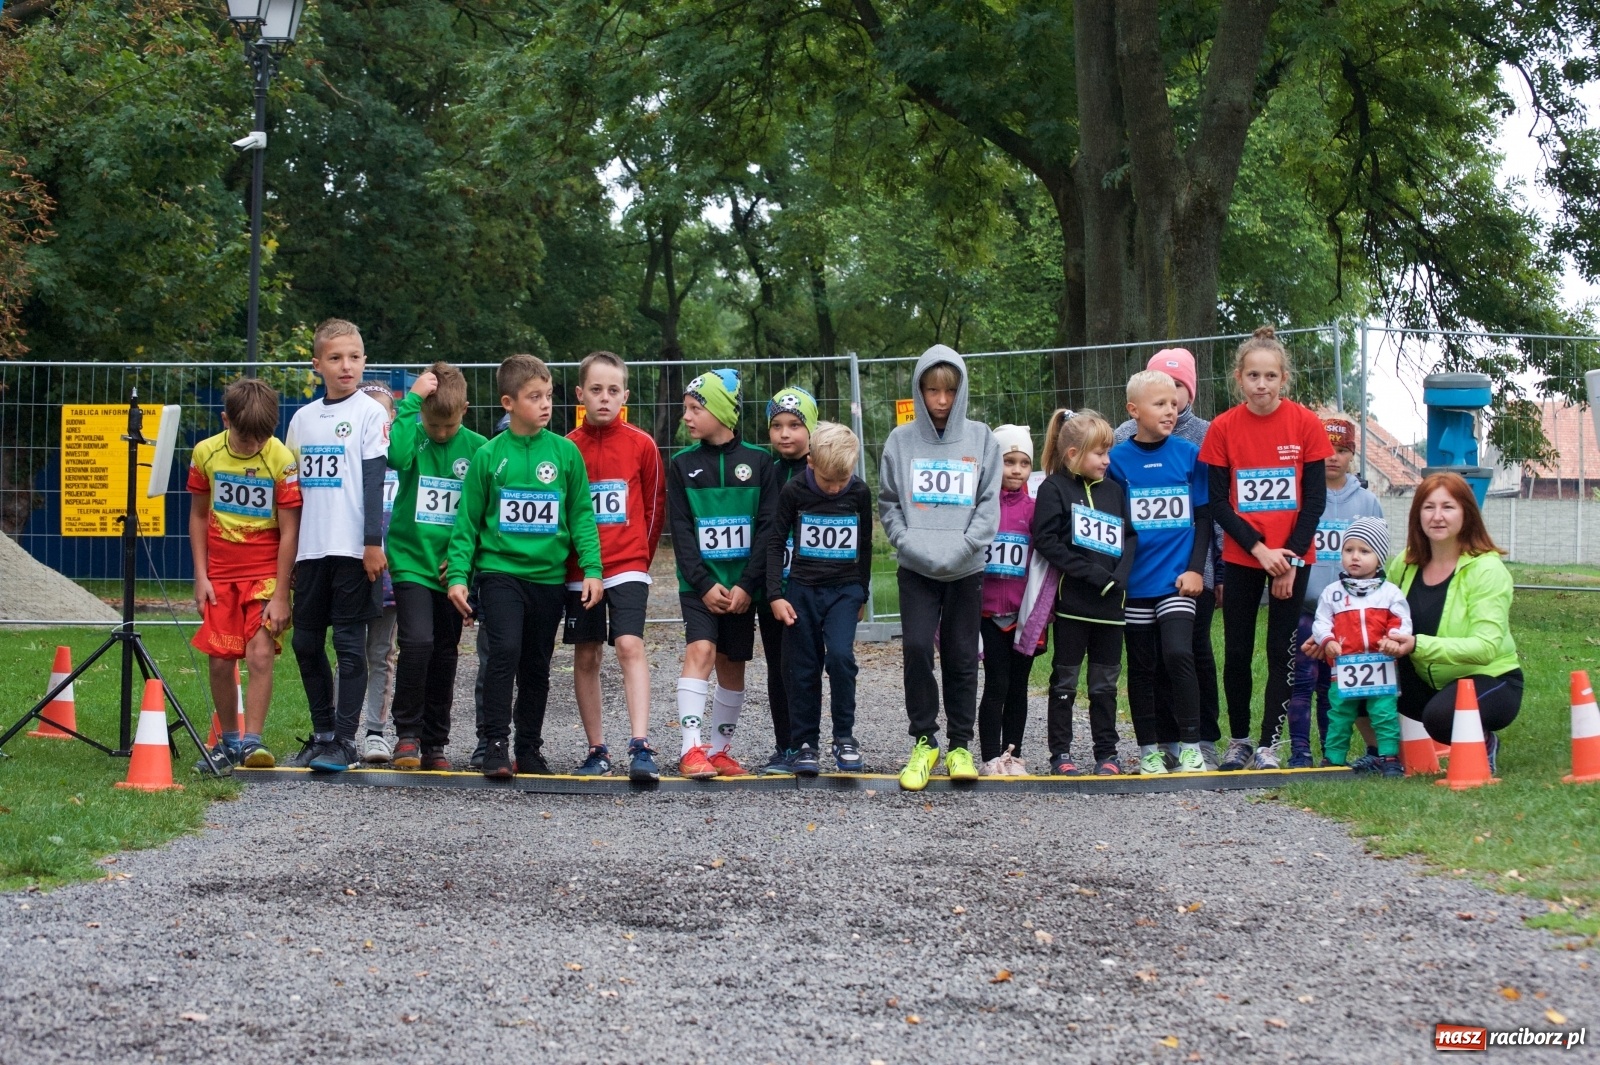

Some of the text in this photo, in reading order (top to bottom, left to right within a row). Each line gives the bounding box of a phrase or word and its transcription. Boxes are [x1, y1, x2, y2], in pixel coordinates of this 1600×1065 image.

[1326, 425, 1346, 433] SKIE
[303, 455, 338, 477] 313
[216, 473, 272, 486] TIME-SPORT.PL
[919, 470, 964, 494] 301
[1244, 478, 1290, 502] 322
[220, 482, 267, 508] 303
[591, 492, 620, 513] 16
[1132, 488, 1187, 496] TIME-SPORT.PL
[506, 500, 553, 523] 304
[1077, 508, 1120, 525] TIME-SPORT.PL
[1136, 496, 1184, 520] 320
[705, 526, 743, 549] 311
[806, 526, 852, 548] 302
[995, 535, 1027, 543] SPORT.PL
[1080, 516, 1117, 545] 315
[1315, 530, 1340, 551] 30
[208, 631, 244, 651] RAFA
[1343, 663, 1388, 688] 321
